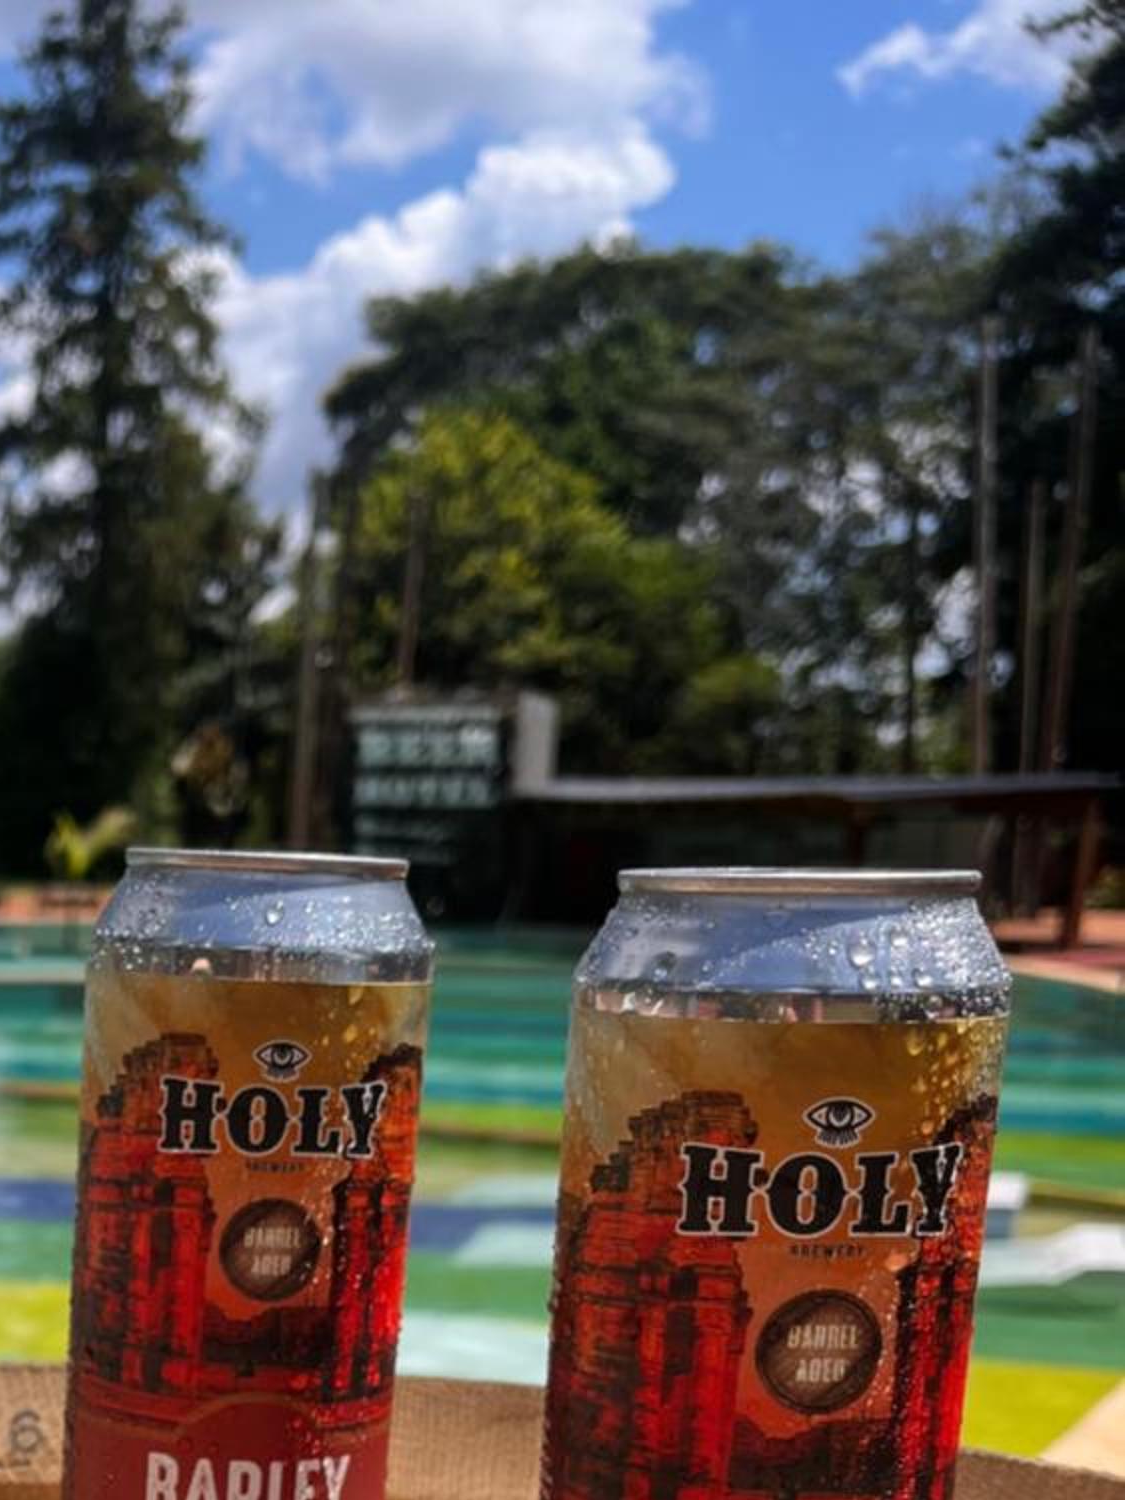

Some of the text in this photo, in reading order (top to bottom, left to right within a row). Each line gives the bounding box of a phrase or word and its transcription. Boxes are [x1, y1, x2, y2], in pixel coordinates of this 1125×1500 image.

[158, 1075, 388, 1157] HOLY
[677, 1143, 964, 1236] HOLY
[786, 1324, 859, 1349] BARREL
